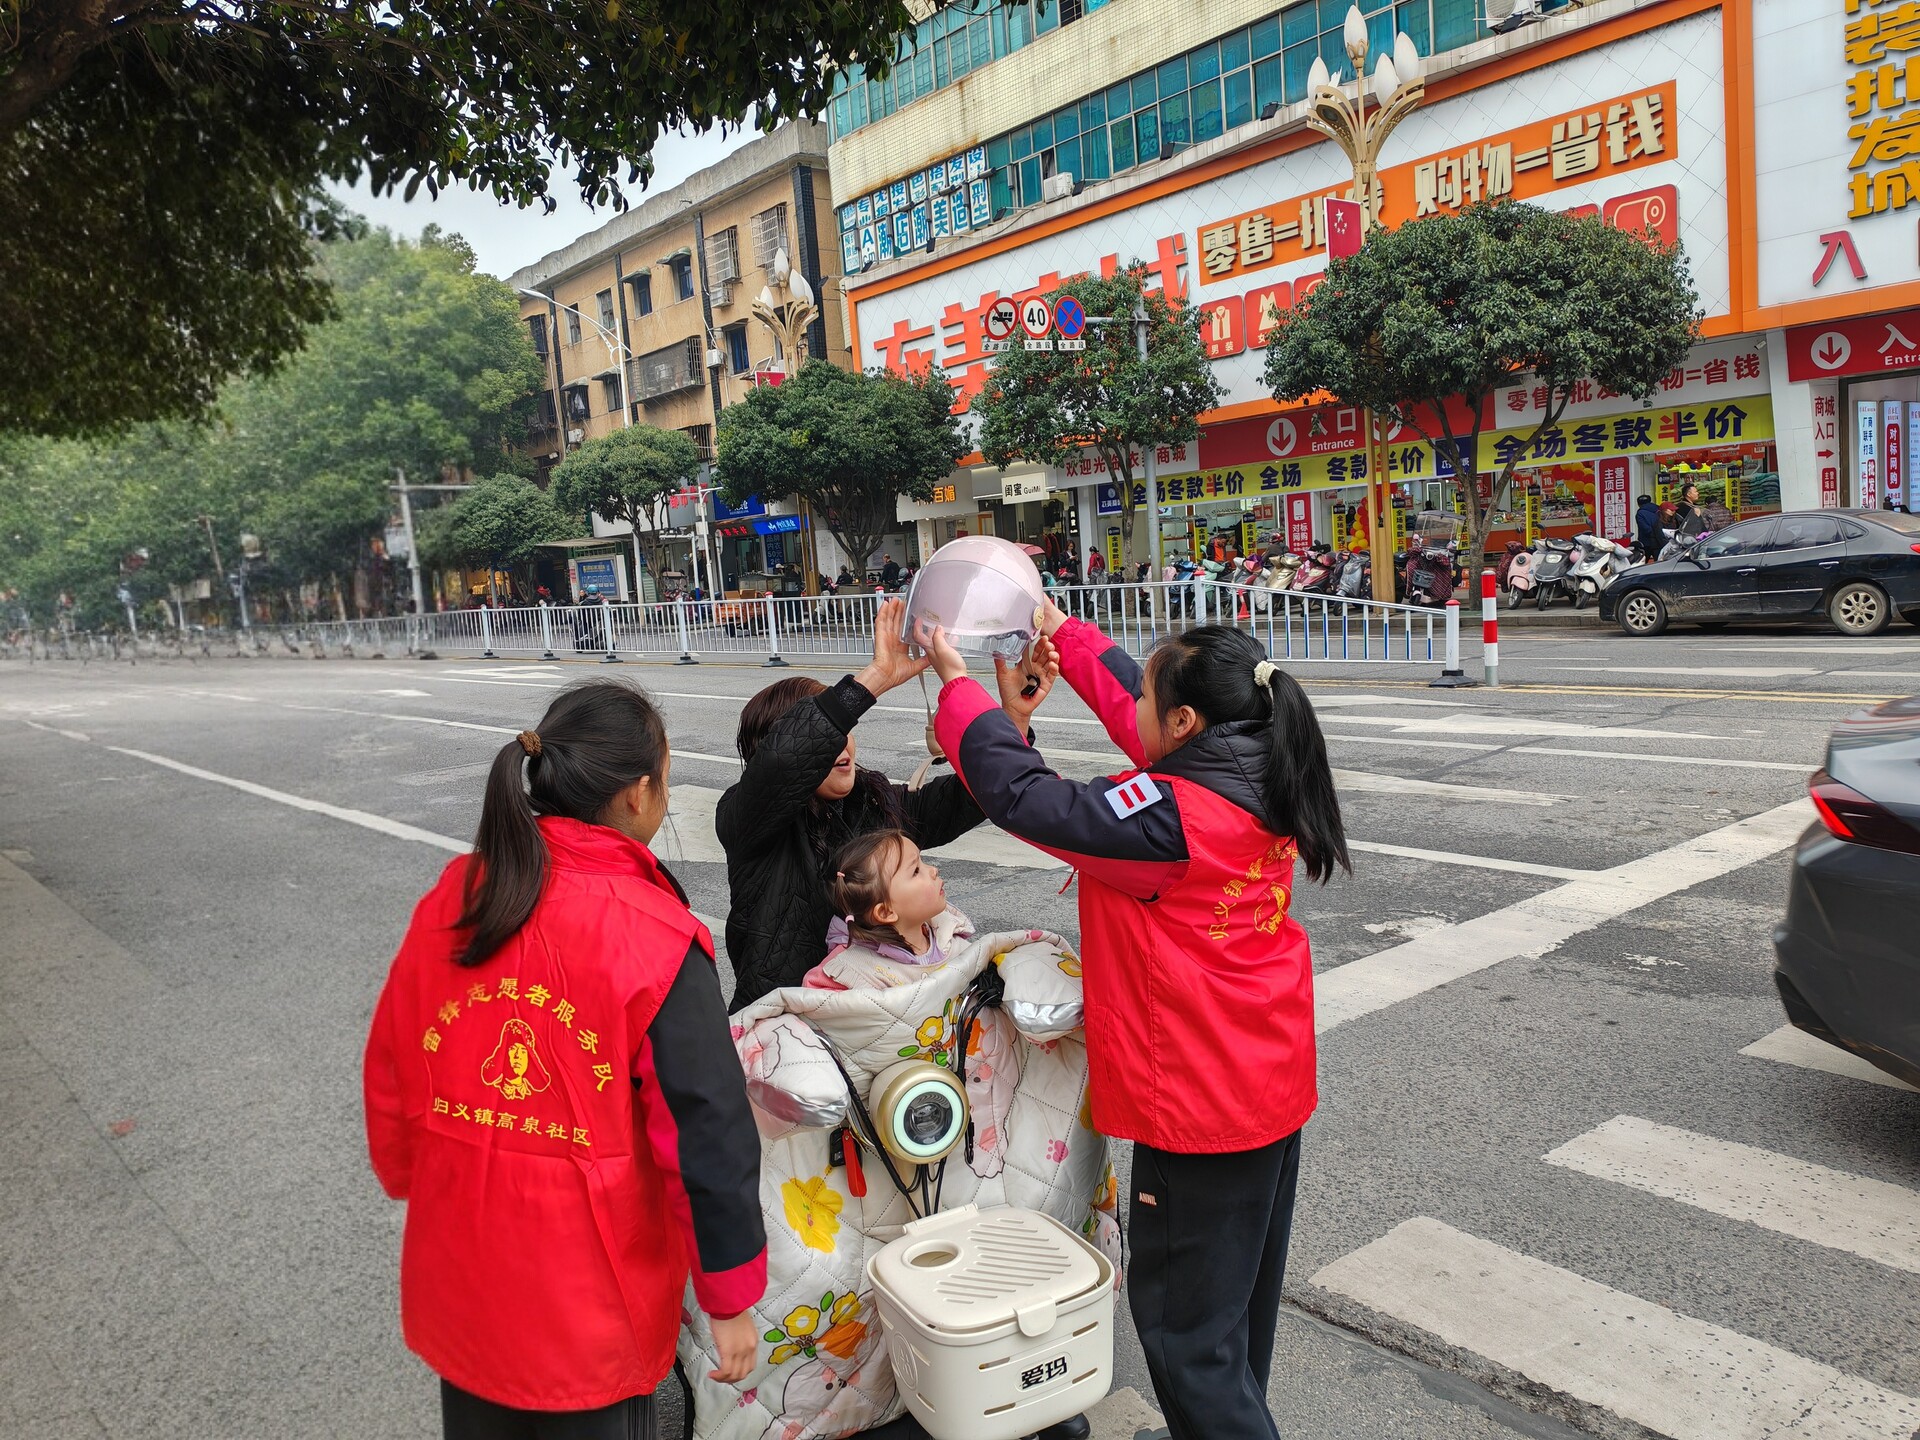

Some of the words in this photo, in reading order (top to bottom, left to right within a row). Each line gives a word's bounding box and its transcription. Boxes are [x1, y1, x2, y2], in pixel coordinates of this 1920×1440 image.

[1845, 0, 1920, 219] 装批发城
[1414, 93, 1664, 217] 购物=省钱
[1028, 308, 1046, 327] 40
[983, 343, 1010, 351] 全路段
[1026, 341, 1051, 349] 全路段
[1060, 341, 1084, 349] 全路段
[1211, 341, 1234, 355] 男装
[1660, 353, 1760, 391] 物=省钱
[1815, 396, 1836, 417] 商城
[1493, 404, 1748, 465] 全场冬款半价
[1815, 422, 1835, 440] 入口
[1311, 438, 1355, 452] Entrance
[1066, 444, 1187, 478] 欢迎光临衣商城
[1604, 467, 1625, 480] 主营
[1005, 483, 1022, 497] 闺蜜
[1024, 485, 1041, 496] GuiMi
[1604, 479, 1625, 491] 项目
[432, 1096, 592, 1147] 归义镇高泉社区
[1021, 1355, 1068, 1390] 爱玛
